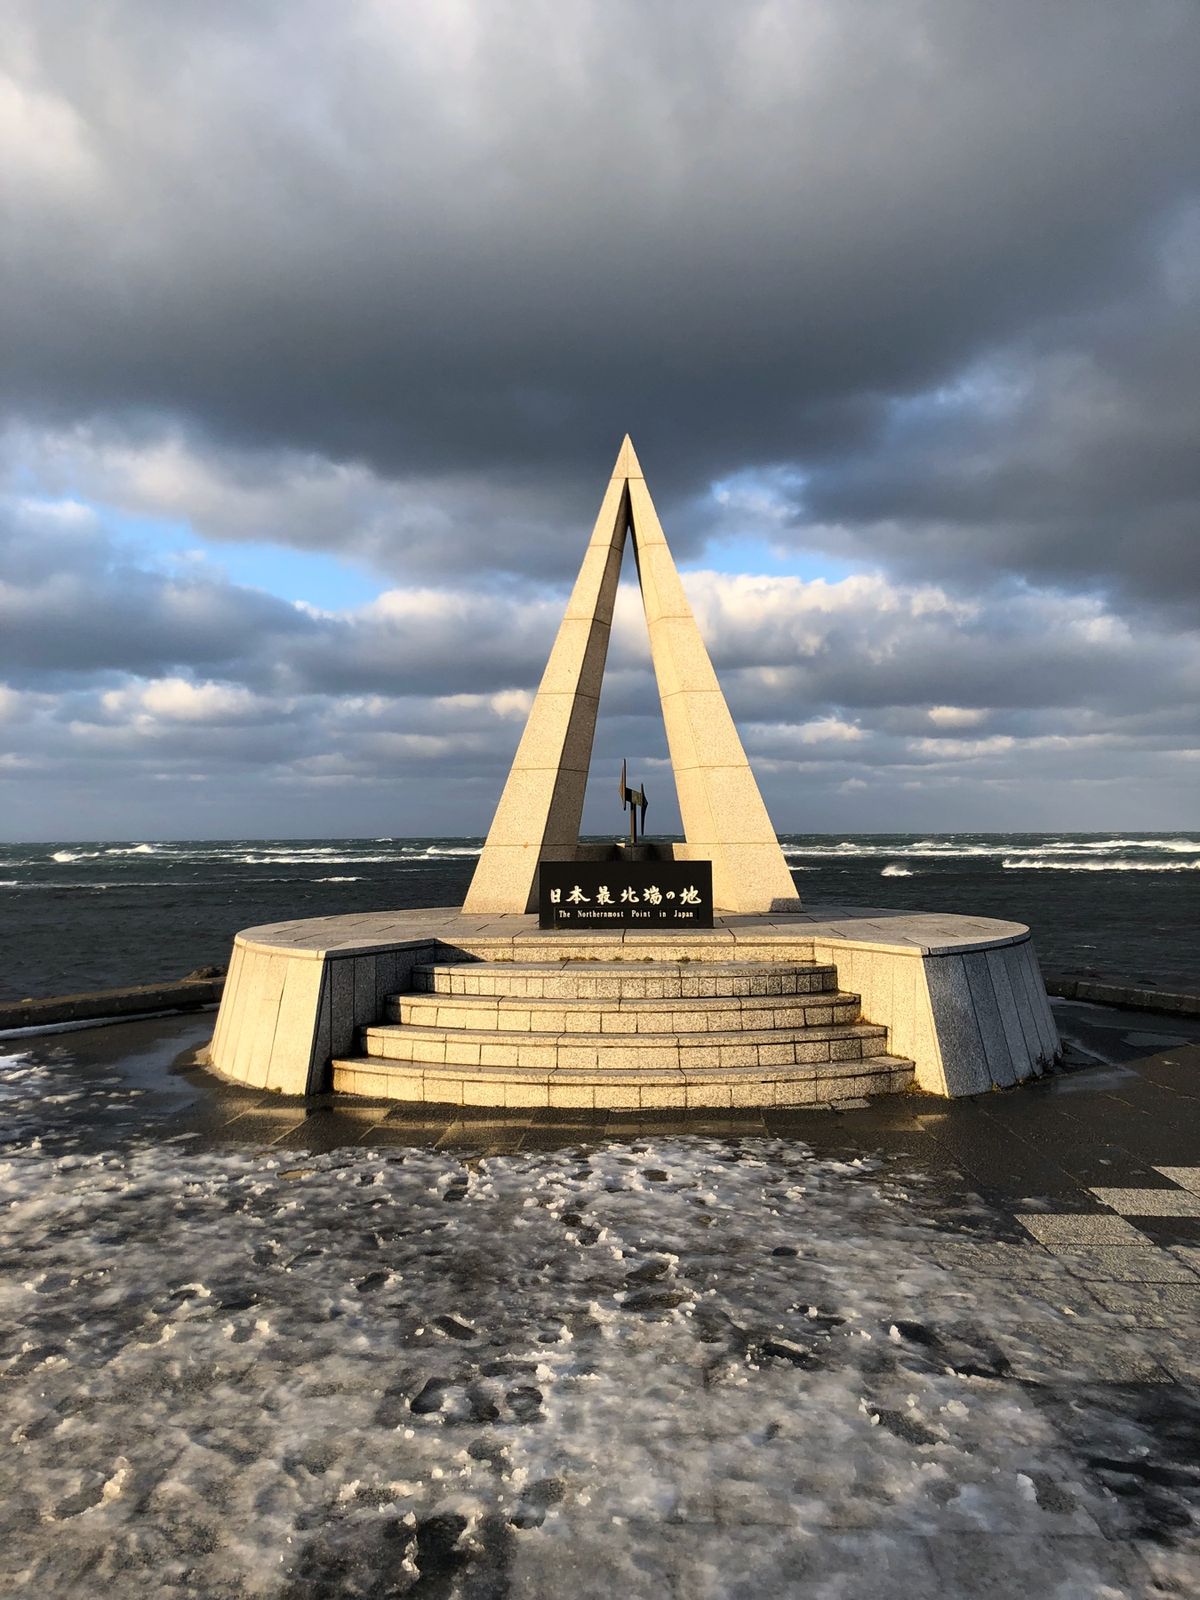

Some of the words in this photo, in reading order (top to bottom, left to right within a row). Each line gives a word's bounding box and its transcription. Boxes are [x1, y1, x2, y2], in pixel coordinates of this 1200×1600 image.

[550, 885, 702, 905] 日本最北端の地
[559, 910, 571, 918] The
[577, 910, 624, 918] Northernmost
[631, 910, 651, 918] Point
[659, 910, 667, 918] in
[673, 910, 694, 919] Japan
